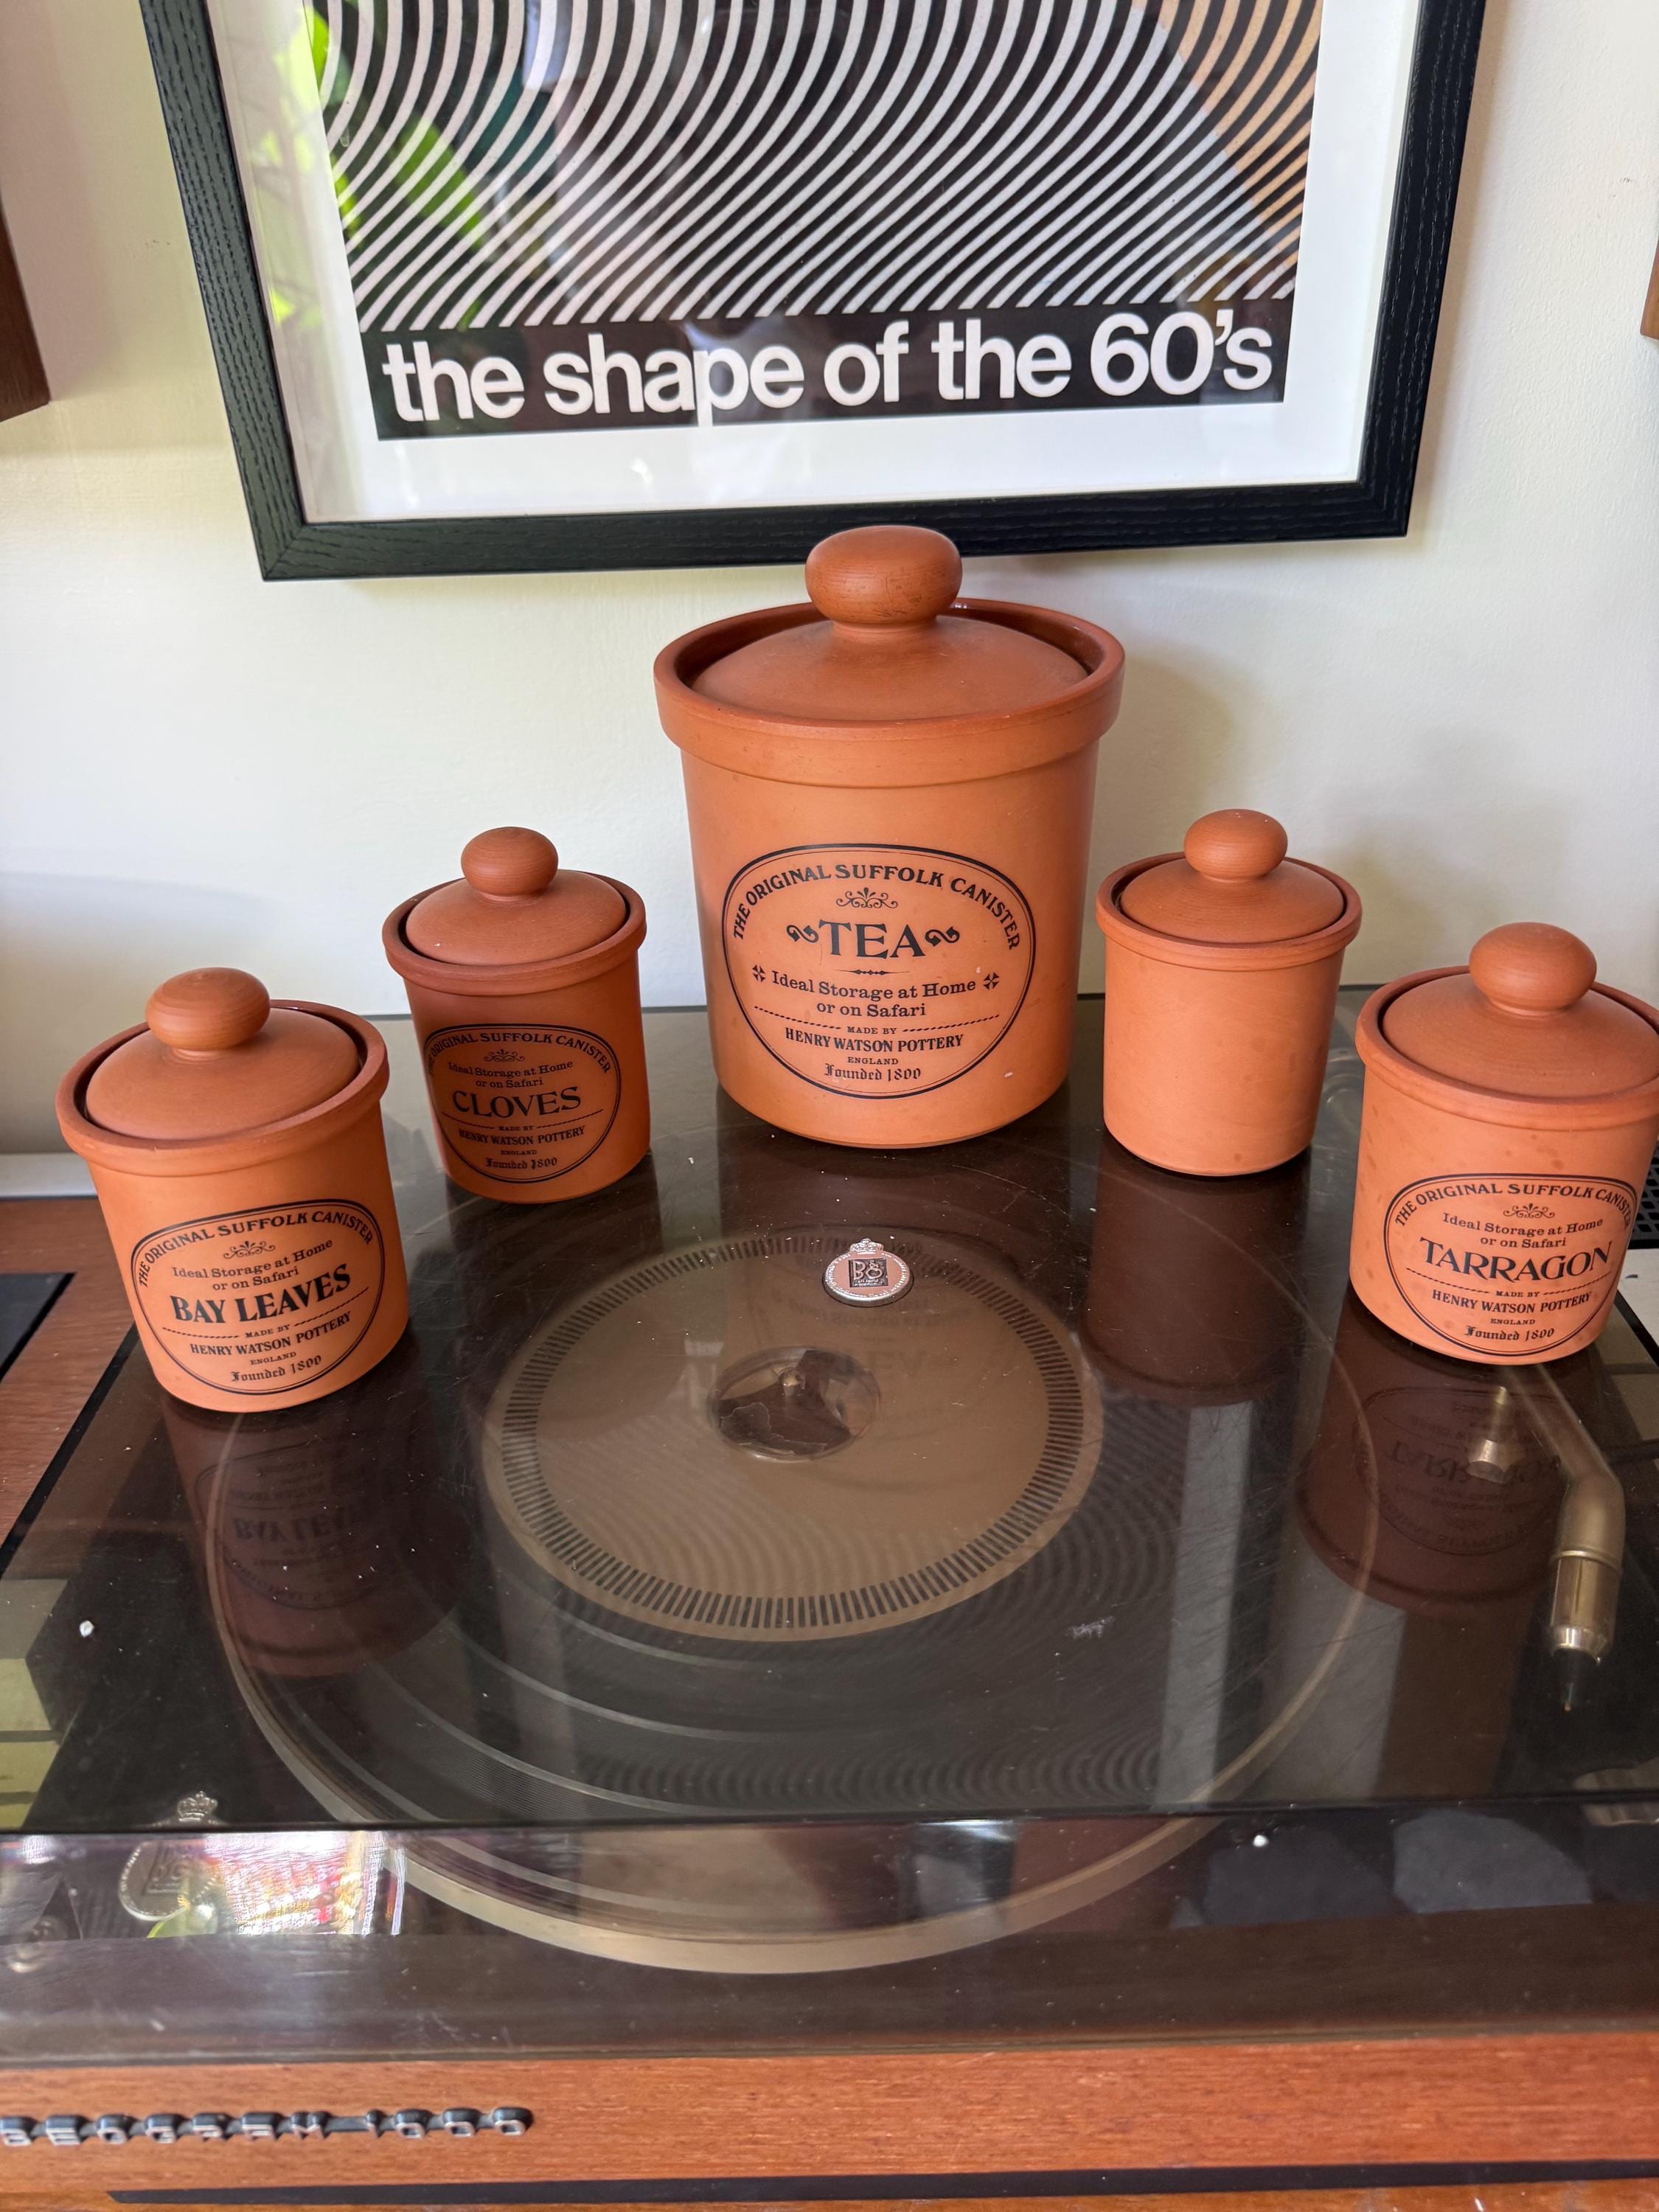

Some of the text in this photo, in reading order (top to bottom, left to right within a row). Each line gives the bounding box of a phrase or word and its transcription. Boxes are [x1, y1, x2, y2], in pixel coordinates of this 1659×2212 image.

[382, 340, 526, 422] the
[543, 333, 806, 427] shape
[824, 321, 910, 406] of
[931, 317, 1073, 401] the
[734, 864, 1020, 950] THE ORIGINAL SUFFOLK CANISTER
[819, 919, 926, 959] TEA
[771, 970, 976, 1001] Ideal Storage at Home
[816, 1002, 926, 1018] or on Safari
[785, 1027, 964, 1052] HENRY WATSON POTTERY
[847, 1026, 878, 1034] MADE
[481, 1032, 552, 1044] SUFFOLK
[555, 1035, 611, 1074] CANISTER
[847, 1057, 899, 1065] ENGLAND
[448, 1062, 473, 1075] Ideal
[475, 1067, 517, 1079] Storage
[519, 1068, 536, 1076] at
[538, 1061, 573, 1074] Home
[476, 1079, 487, 1088] or
[505, 1077, 543, 1088] Safari
[824, 1063, 921, 1082] Founded 1800
[452, 1086, 581, 1118] CLOVES
[459, 1125, 585, 1145] HENRY WATSON POTTERY
[485, 1158, 557, 1170] Founded 1800
[1395, 1201, 1417, 1227] THE
[1416, 1183, 1503, 1206] ORIGINAL
[1507, 1183, 1593, 1198] SUFFOLK
[1443, 1212, 1603, 1237] Ideal Storage at Home
[139, 1211, 372, 1287] THE ORIGINAL SUFFOLK CANISTER
[1480, 1237, 1566, 1248] or on Safari
[172, 1239, 333, 1279] Ideal Storage at Home
[1420, 1237, 1613, 1283] TARRAGON
[212, 1266, 300, 1291] or on Safari
[170, 1264, 351, 1324] BAY LEAVES
[1432, 1290, 1592, 1314] HENRY WATSON POTTERY
[189, 1311, 352, 1355] HENRY WATSON POTTERY
[244, 1324, 290, 1338] MADE BY
[1464, 1326, 1554, 1341] Founded 1800
[231, 1355, 322, 1382] Founded 1800
[250, 1351, 296, 1366] ENGLAND
